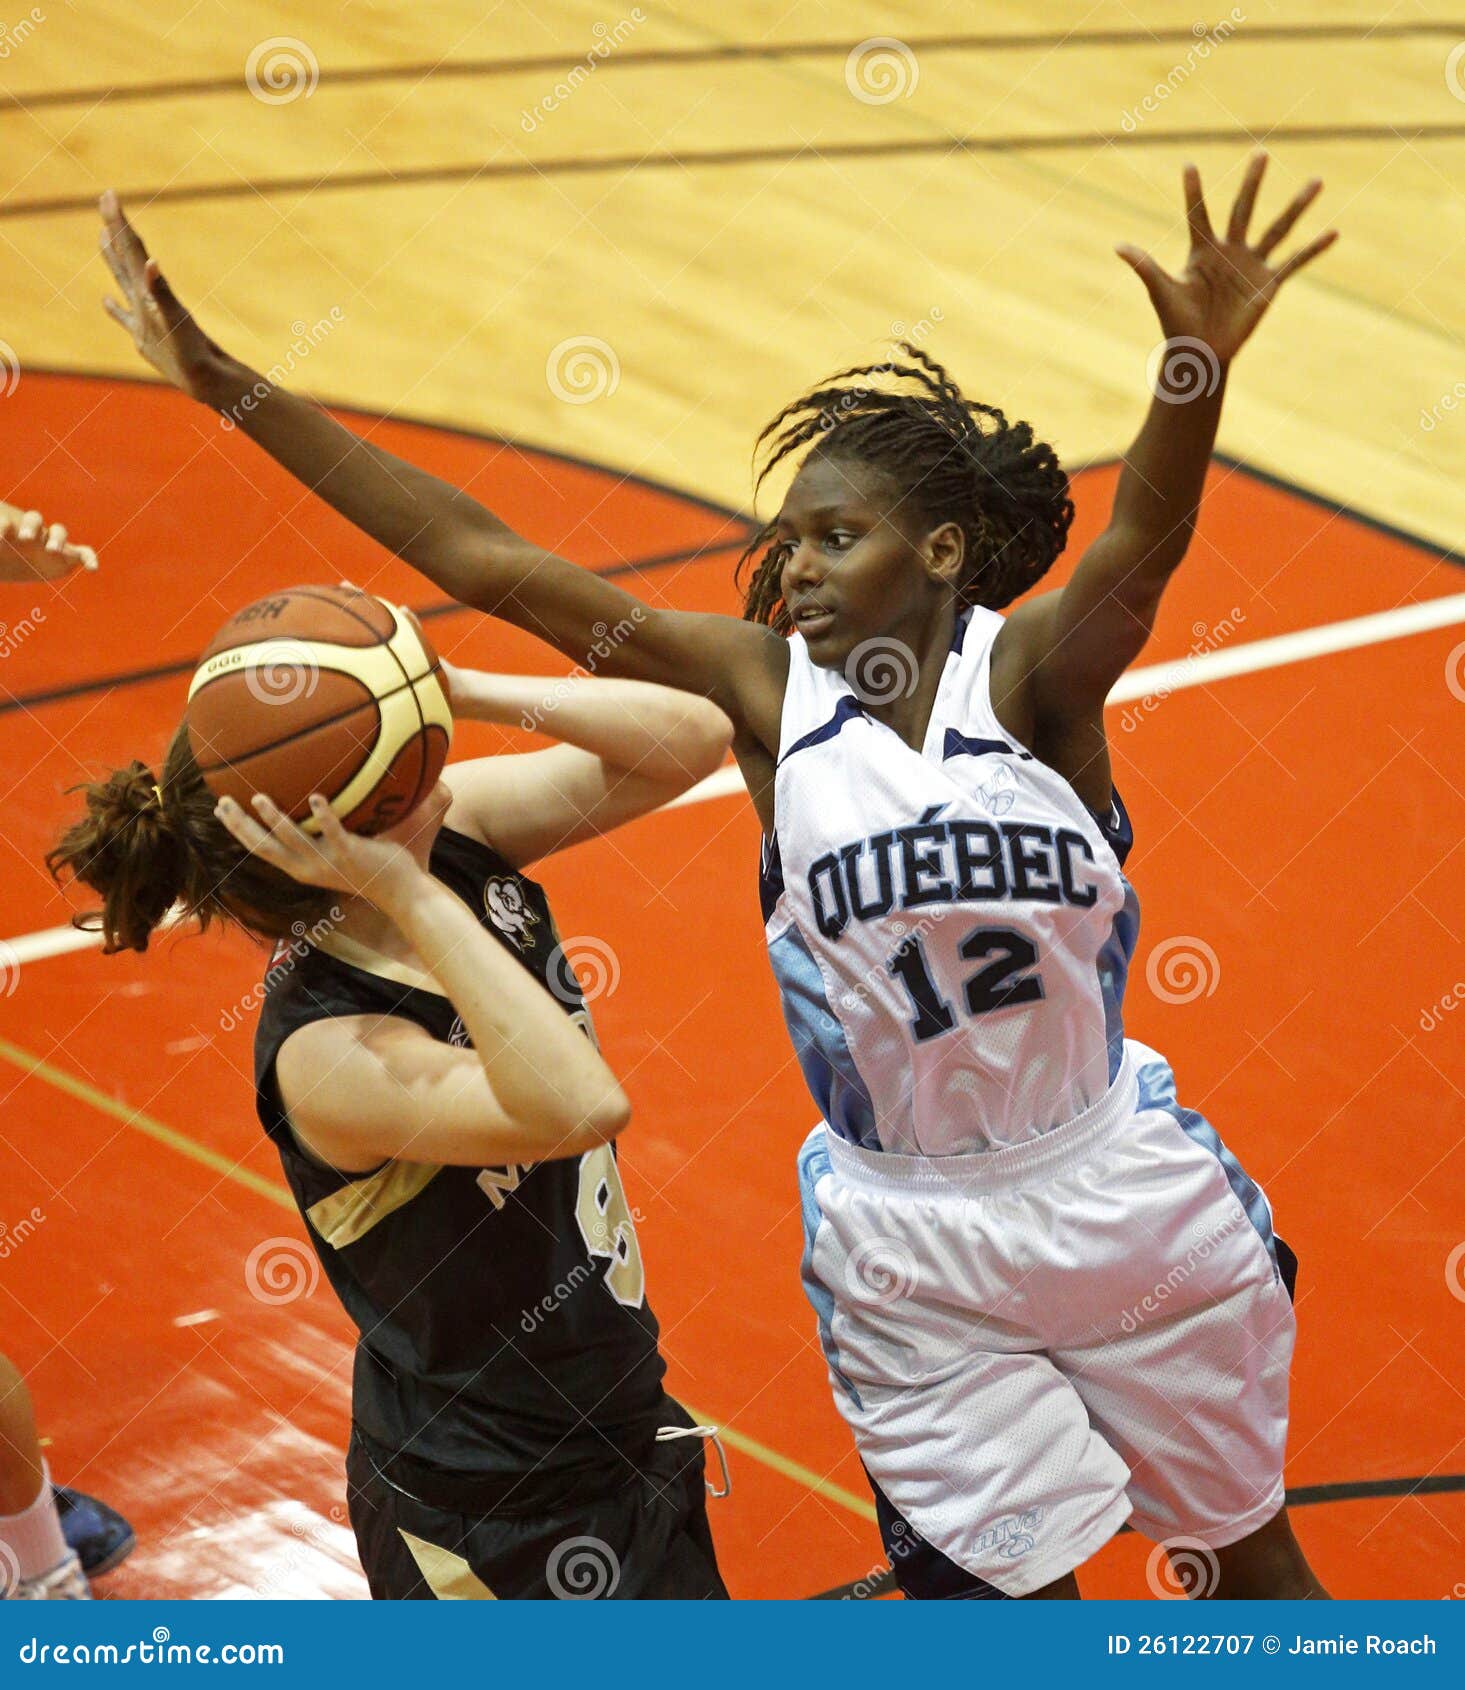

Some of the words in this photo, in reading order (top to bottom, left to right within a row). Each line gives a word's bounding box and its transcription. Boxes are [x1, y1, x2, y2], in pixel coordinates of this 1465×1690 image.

[807, 802, 1099, 942] QUÉBEC
[886, 926, 1046, 1044] 12
[575, 1141, 644, 1310] 9
